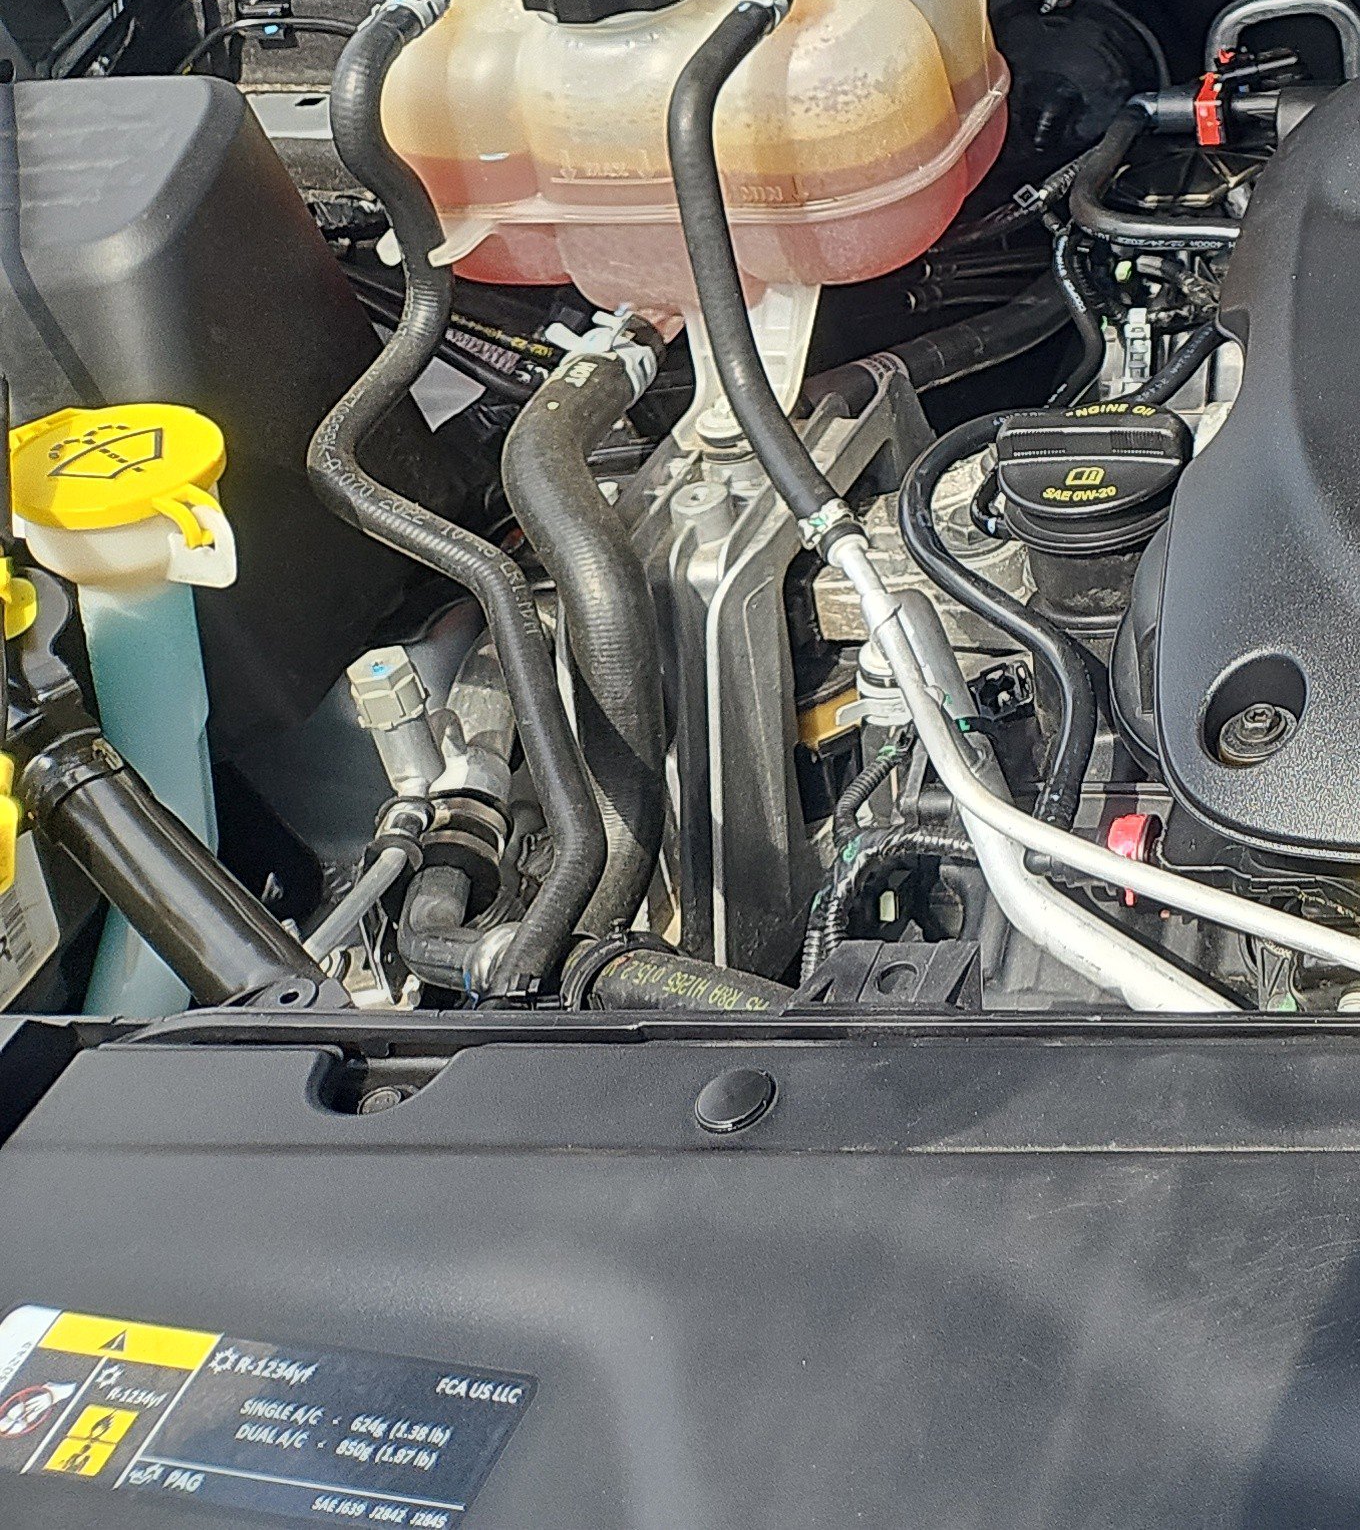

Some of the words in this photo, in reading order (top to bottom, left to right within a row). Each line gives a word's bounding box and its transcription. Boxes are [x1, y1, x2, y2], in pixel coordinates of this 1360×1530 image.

[1042, 487, 1072, 501] SAE
[1071, 485, 1117, 501] 0W-20
[233, 1352, 318, 1386] R-1234yf
[105, 1387, 168, 1408] R-1234yf
[435, 1375, 469, 1398] FCA
[469, 1379, 496, 1401] US
[491, 1383, 523, 1405] LLC
[239, 1398, 295, 1422] SINGLE
[291, 1404, 326, 1426] A/C
[350, 1414, 388, 1439] 624g
[388, 1418, 427, 1442] (1.38
[426, 1424, 452, 1448] lb)
[234, 1423, 281, 1446] DUAL
[277, 1428, 311, 1450] A/C
[335, 1437, 373, 1463] 850g
[374, 1442, 413, 1465] (1.87
[412, 1447, 439, 1471] lb)
[162, 1470, 206, 1493] PAG
[311, 1494, 339, 1513] SAE
